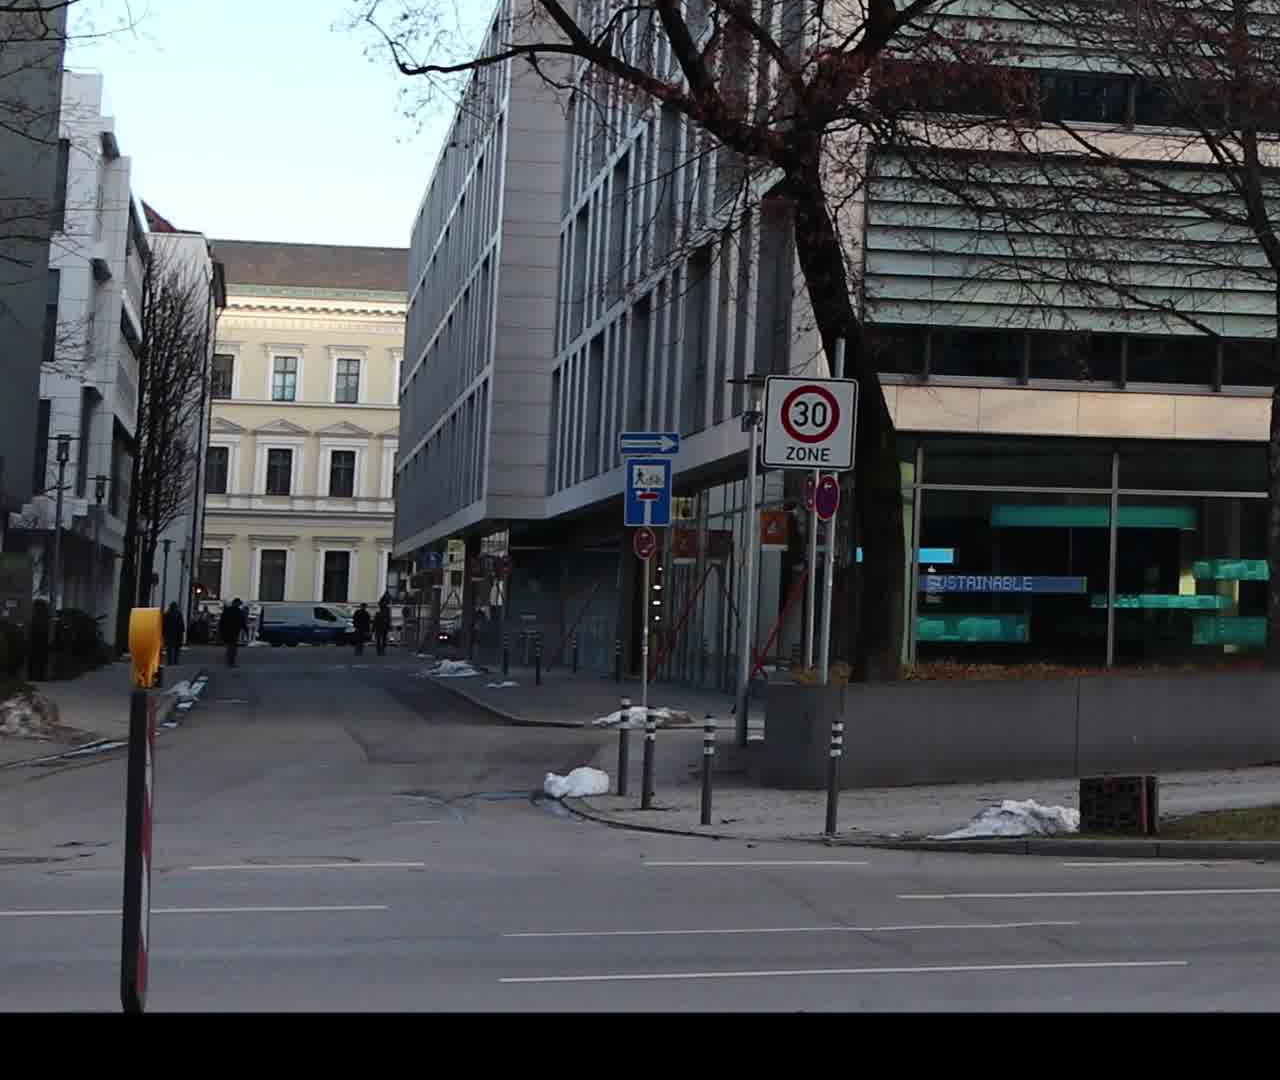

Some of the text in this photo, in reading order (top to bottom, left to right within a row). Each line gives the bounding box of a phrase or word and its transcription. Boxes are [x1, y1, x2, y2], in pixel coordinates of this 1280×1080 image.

[793, 401, 828, 427] 30
[786, 446, 831, 462] ZONE
[927, 576, 1033, 591] SUSTAINABLE
